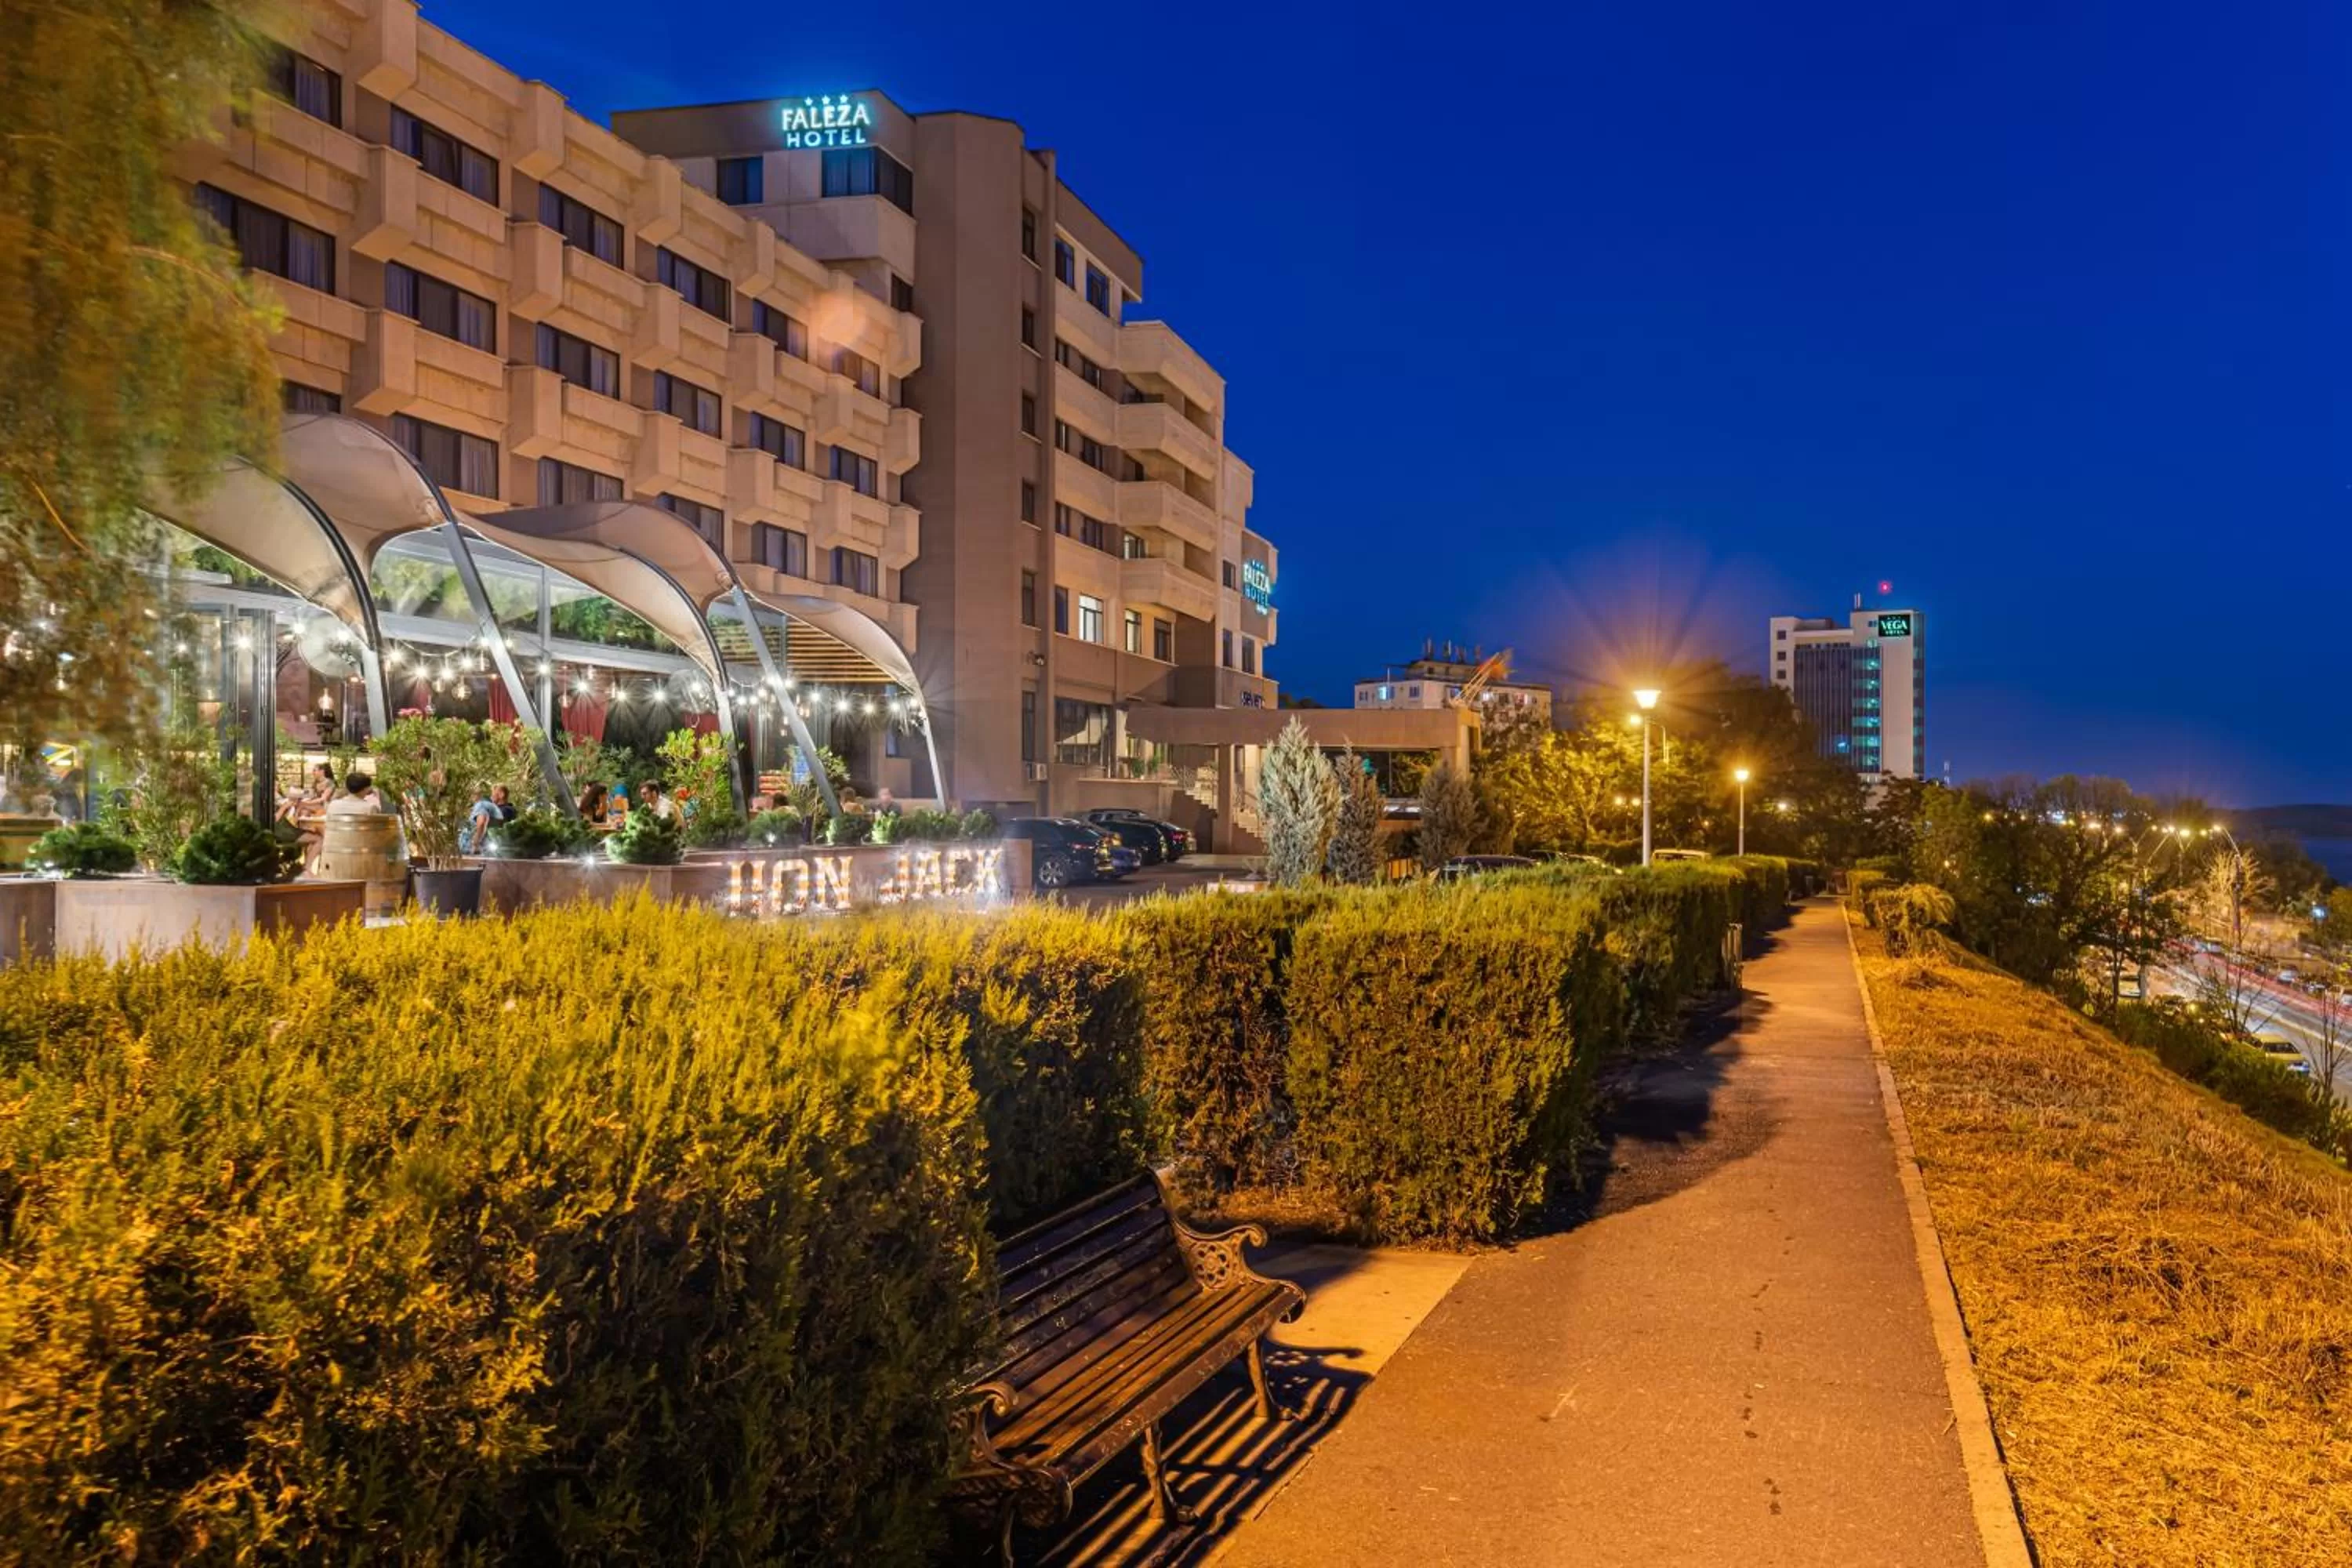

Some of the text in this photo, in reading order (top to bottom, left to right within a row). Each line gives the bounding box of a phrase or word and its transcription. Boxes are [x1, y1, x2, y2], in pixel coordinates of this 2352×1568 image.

[782, 103, 871, 131] FALEZA
[786, 128, 866, 147] HOTEL
[1243, 585, 1269, 607] HOTEL
[1880, 619, 1908, 630] VEGA
